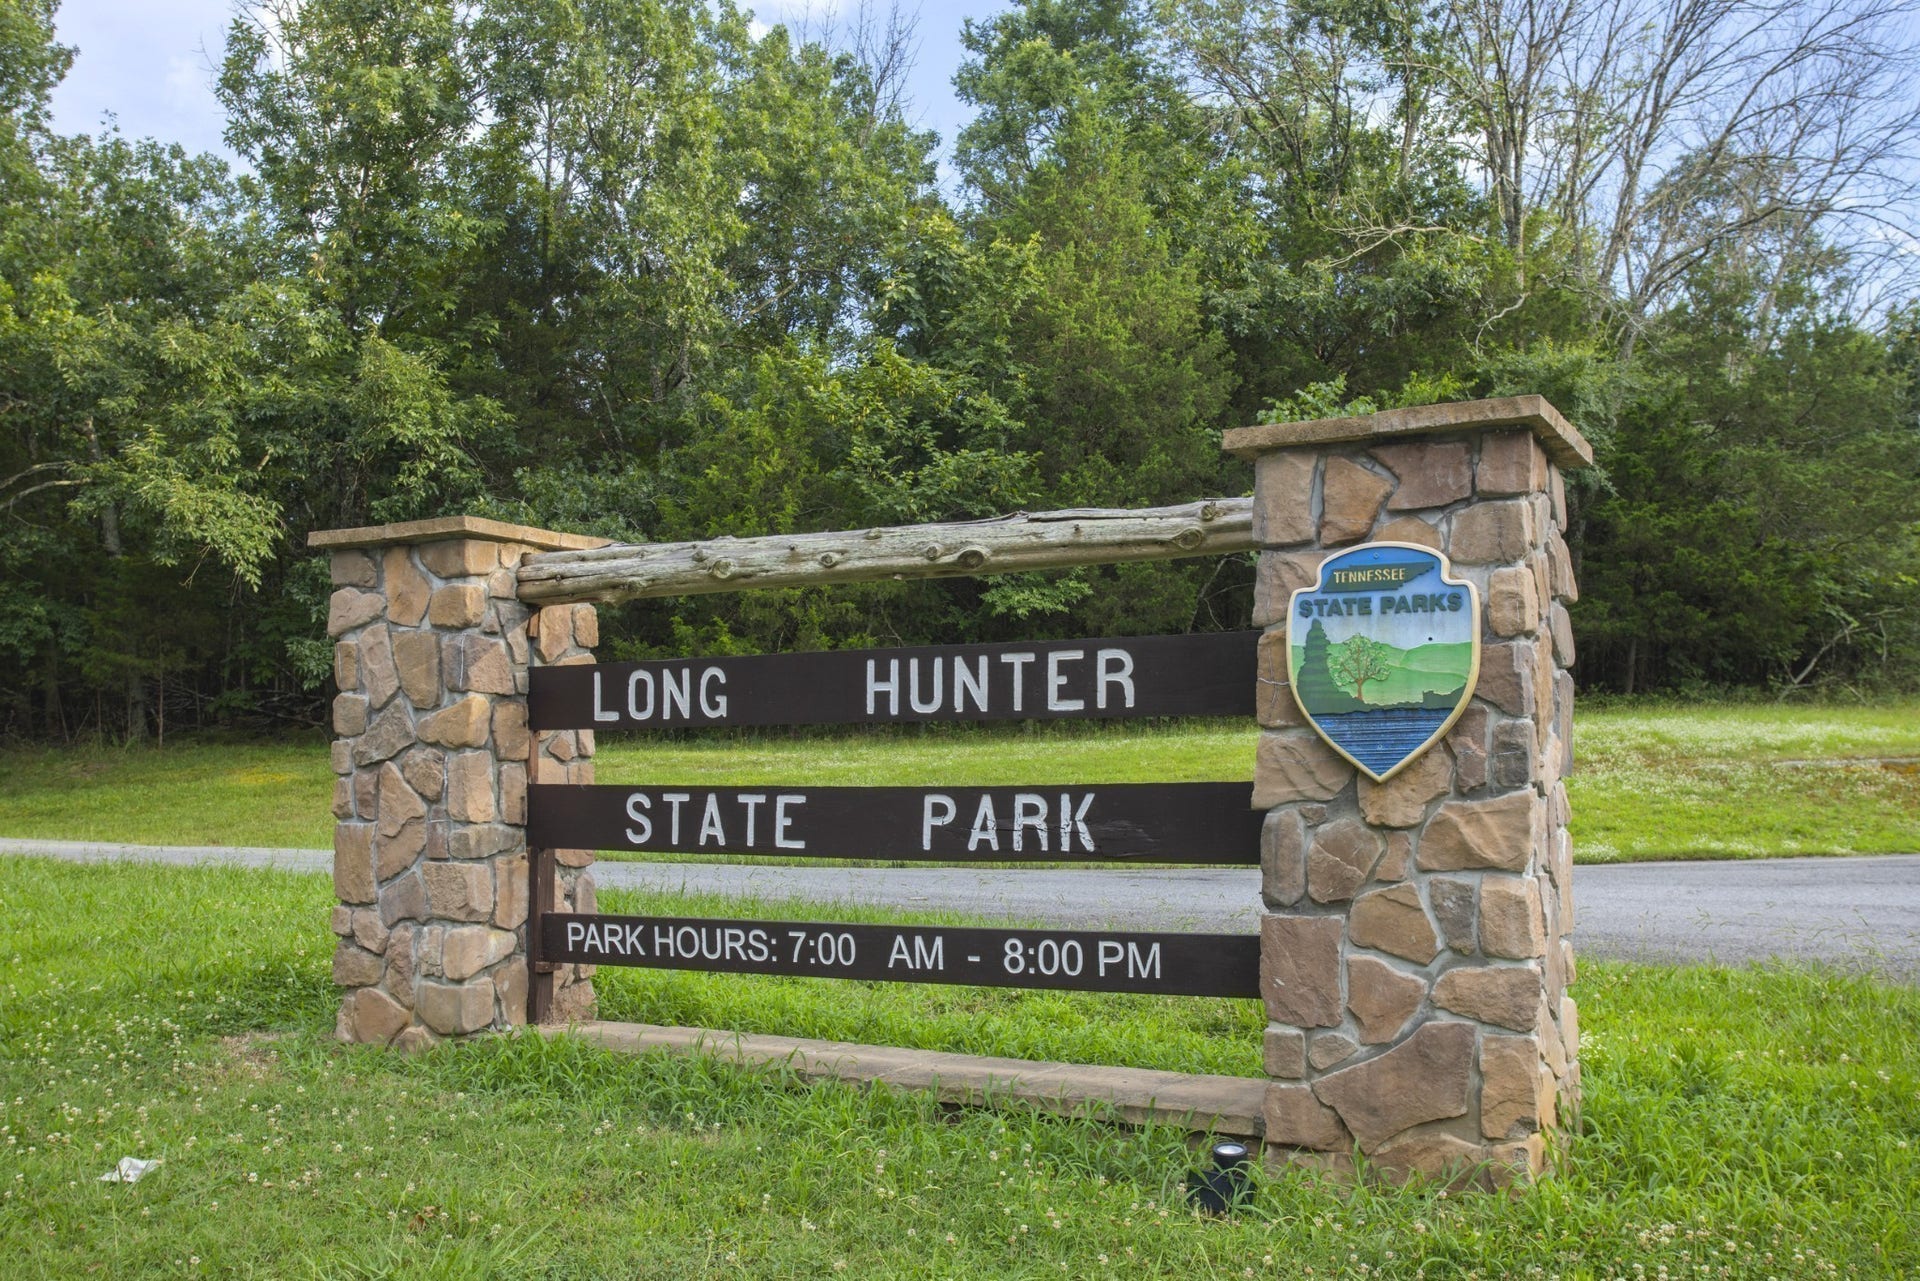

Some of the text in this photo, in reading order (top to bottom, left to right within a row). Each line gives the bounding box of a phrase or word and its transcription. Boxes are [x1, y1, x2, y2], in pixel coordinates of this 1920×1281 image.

[1333, 567, 1406, 584] TENNESSEE
[1299, 592, 1463, 618] STATE PARKS
[593, 648, 1135, 722] LONG HUNTER
[625, 792, 1096, 852] STATE PARK
[567, 922, 646, 956] PARK
[654, 925, 778, 962] HOURS:
[787, 931, 857, 966] 7:00
[888, 935, 944, 971] AM
[1003, 937, 1084, 976] 8:00
[1098, 941, 1161, 979] PM
